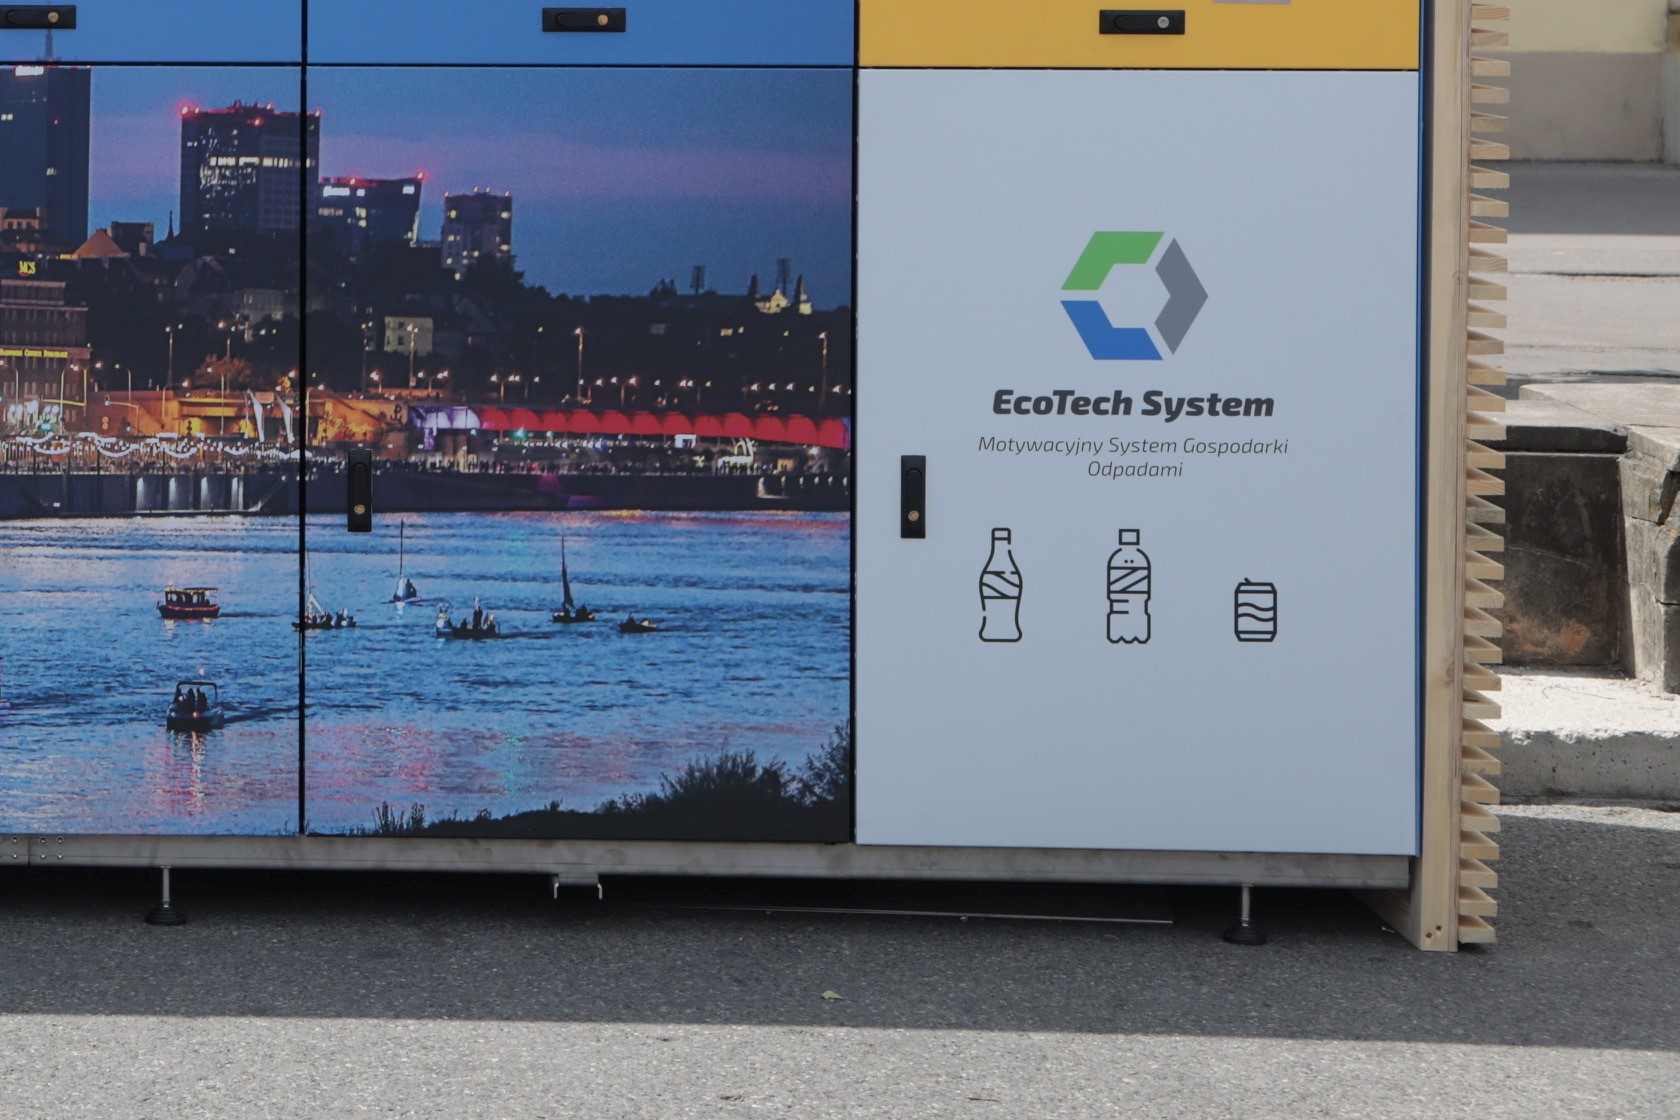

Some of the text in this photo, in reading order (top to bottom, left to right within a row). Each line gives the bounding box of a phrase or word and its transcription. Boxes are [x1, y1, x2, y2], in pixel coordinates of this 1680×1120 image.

[992, 389, 1275, 423] EcoTech System
[978, 436, 1289, 457] Motywacyjny System Gospodarki
[1088, 461, 1183, 480] Odpadami
